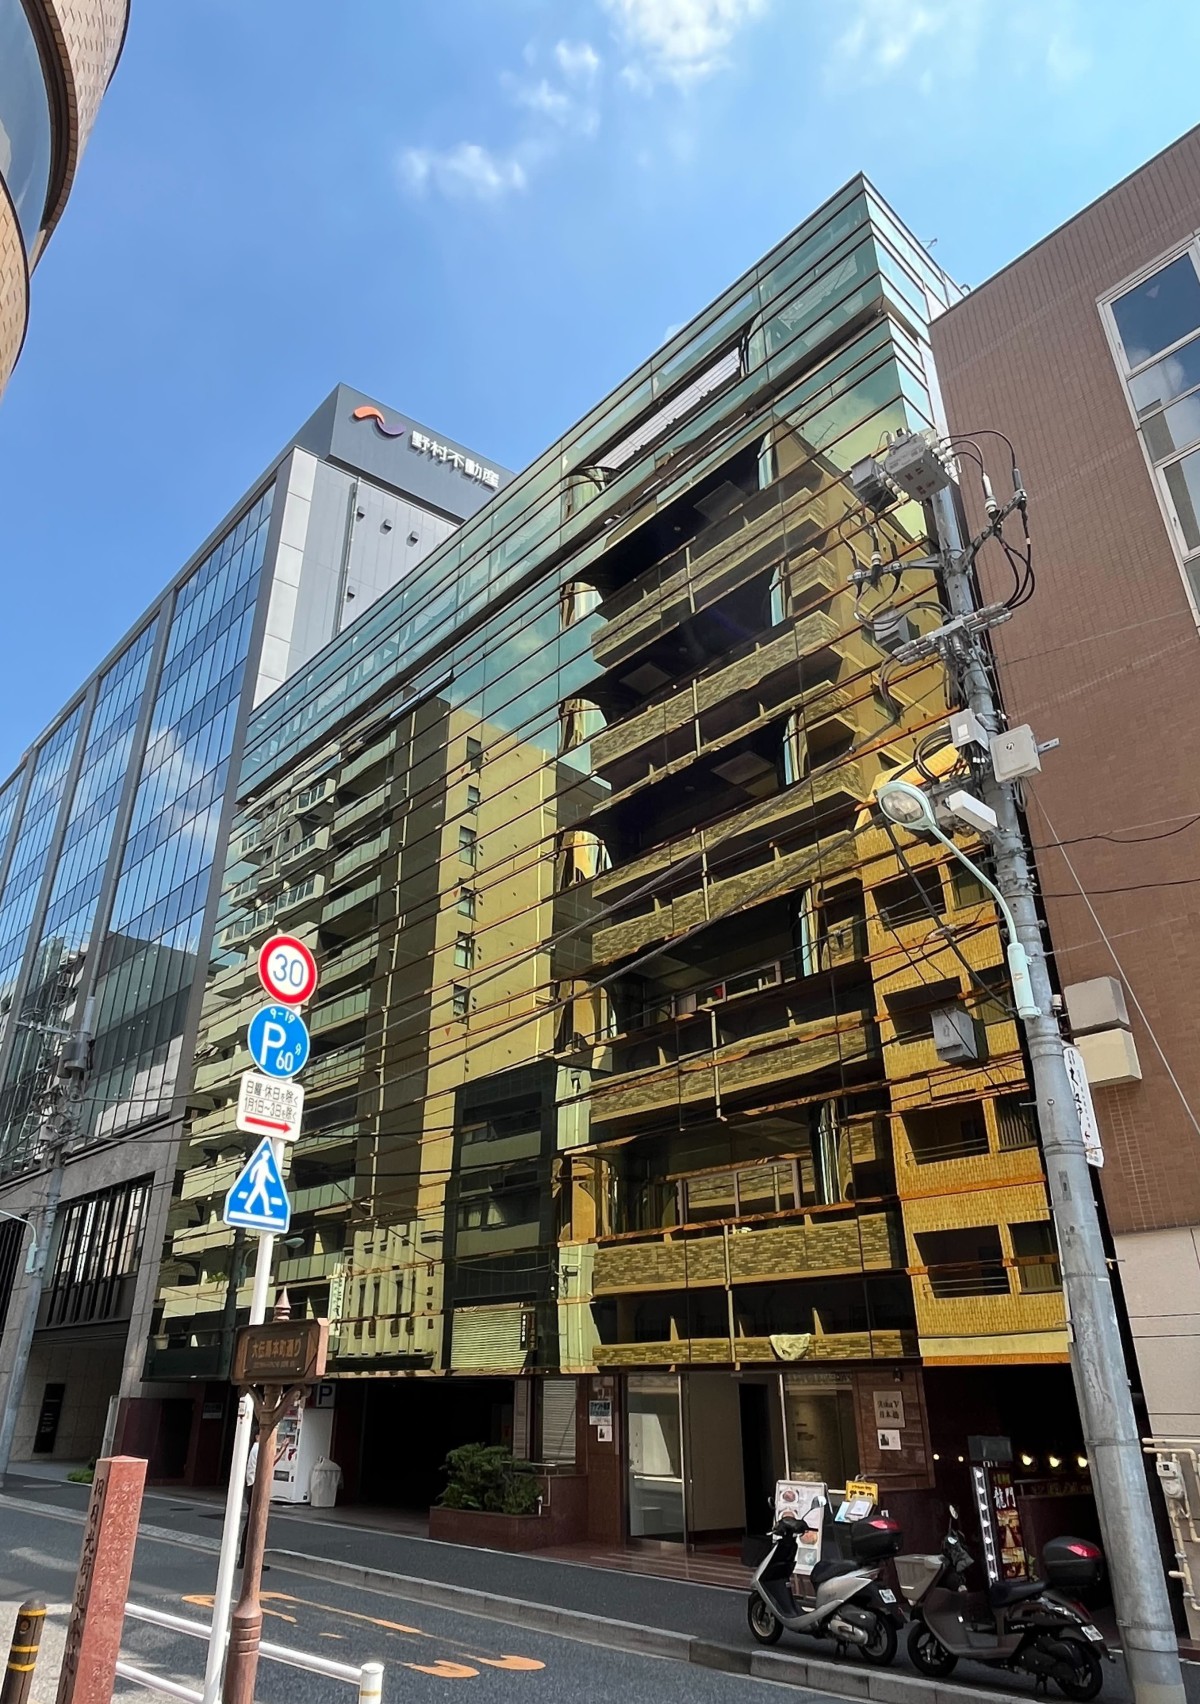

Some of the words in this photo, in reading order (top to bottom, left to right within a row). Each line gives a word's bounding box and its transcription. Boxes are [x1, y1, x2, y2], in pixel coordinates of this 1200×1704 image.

[412, 430, 500, 488] 野村不動産
[273, 953, 304, 987] 30
[270, 1008, 295, 1024] 9-19
[260, 1021, 287, 1066] P
[319, 1385, 333, 1405] P
